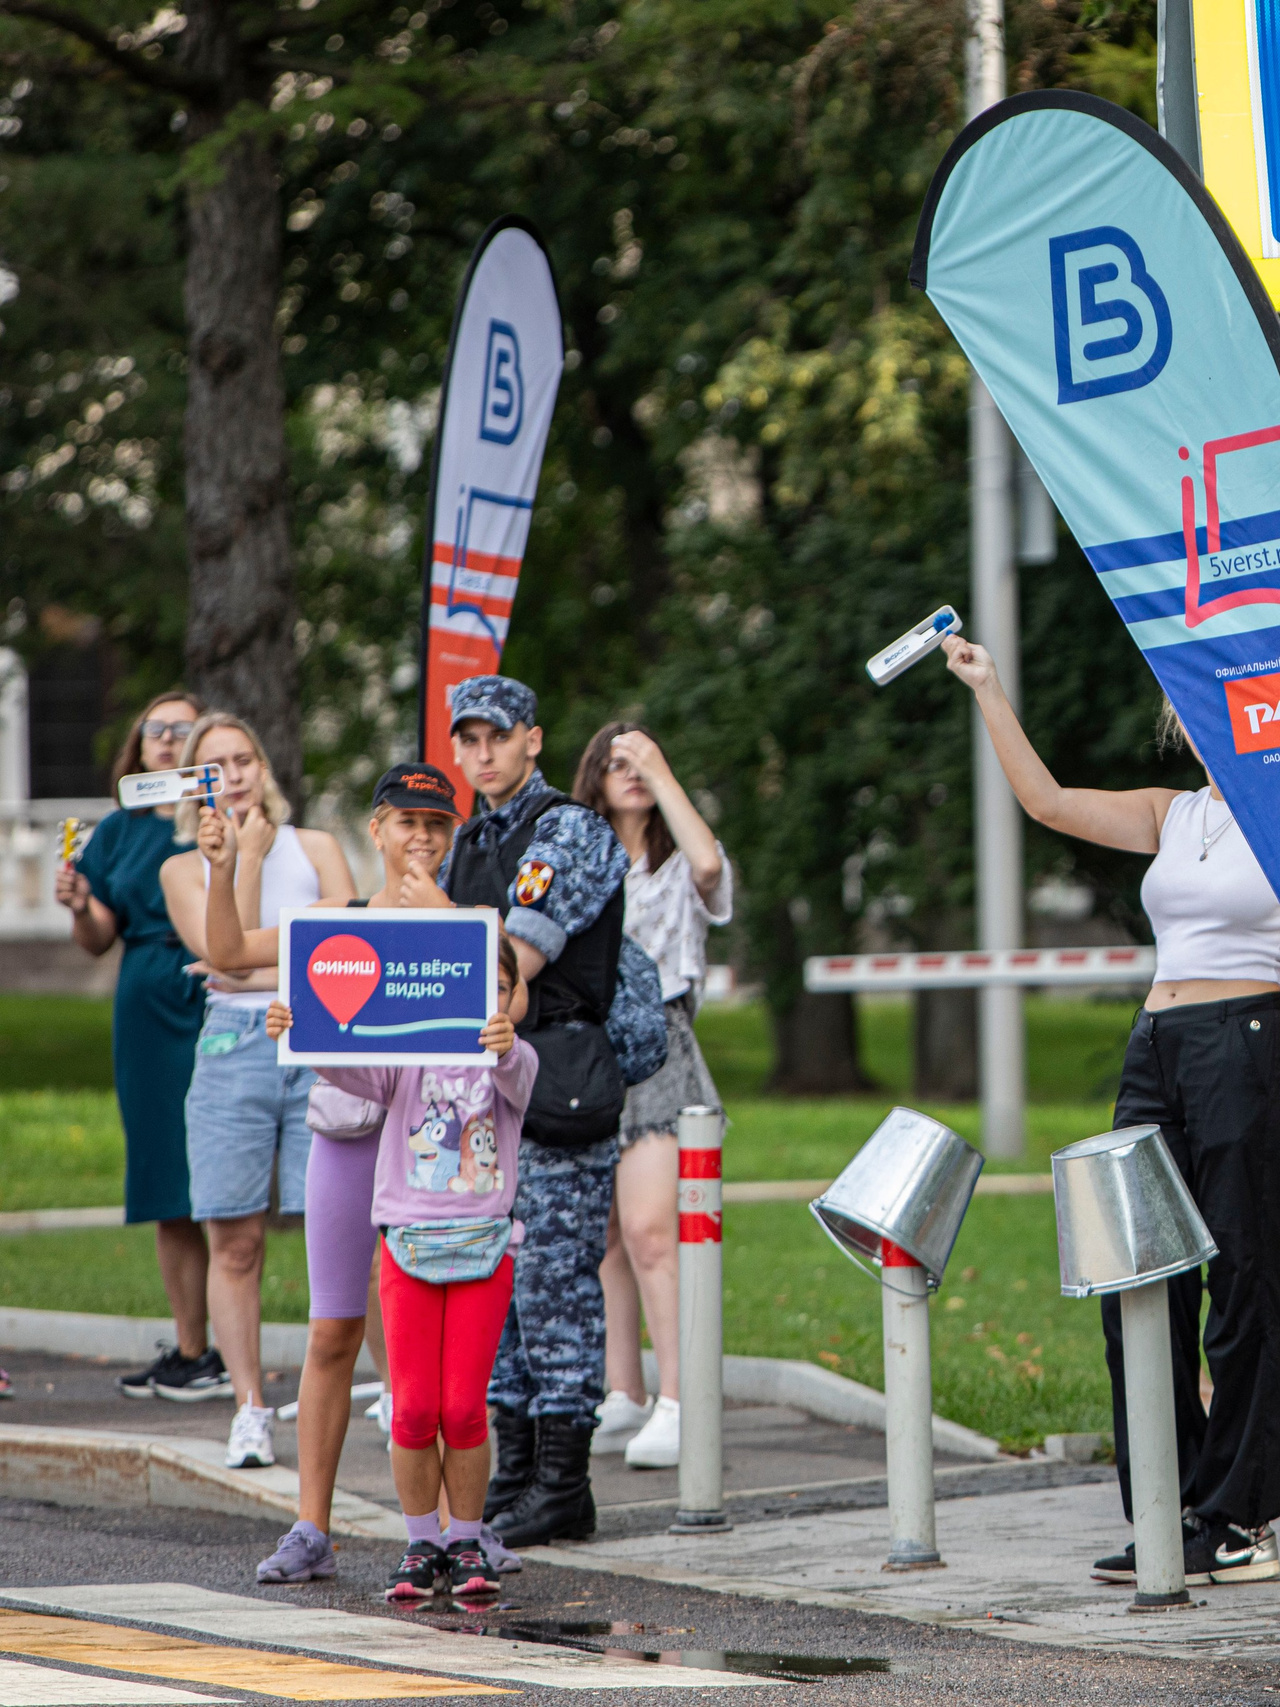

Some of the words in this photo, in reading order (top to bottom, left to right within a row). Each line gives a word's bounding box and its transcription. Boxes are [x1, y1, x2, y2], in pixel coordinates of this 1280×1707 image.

[1263, 753, 1280, 765] ОАО
[312, 960, 376, 976] ФИНИШ
[385, 962, 406, 977] ЗА
[408, 962, 418, 977] 5
[421, 958, 472, 978] ВЁРСТ
[385, 982, 446, 999] ВИДНО
